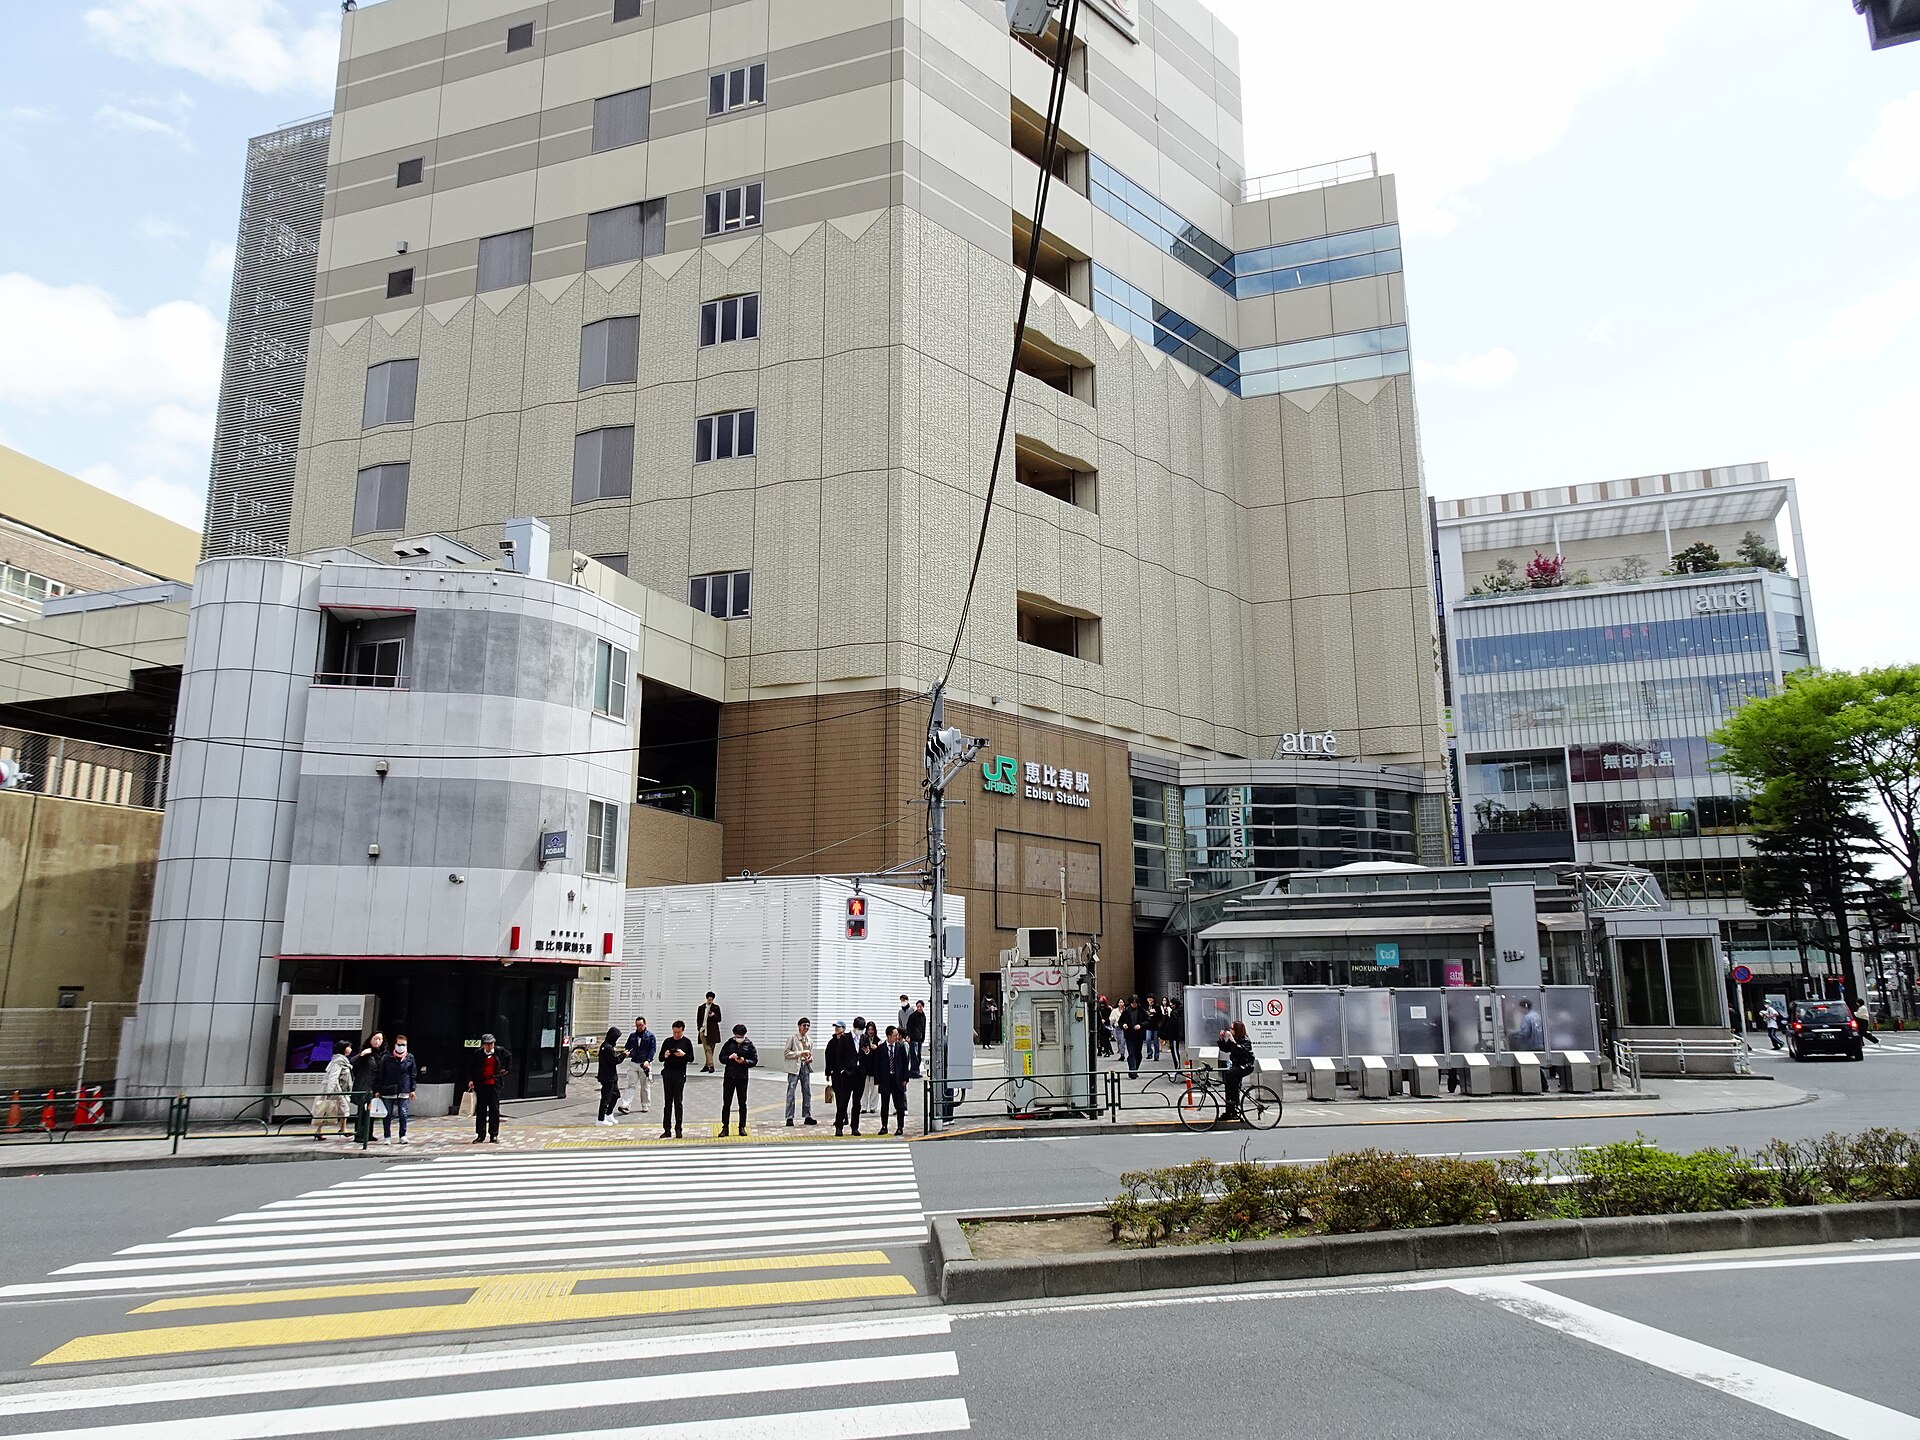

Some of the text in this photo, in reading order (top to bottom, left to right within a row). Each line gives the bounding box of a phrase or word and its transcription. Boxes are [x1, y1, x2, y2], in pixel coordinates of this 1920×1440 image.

[1695, 587, 1750, 611] atré
[1282, 728, 1337, 753] atré
[983, 755, 1018, 785] JR
[1602, 751, 1676, 770] 無印良品
[1024, 761, 1090, 793] 恵比寿駅
[1025, 785, 1090, 808] Ebisu Station
[545, 847, 565, 855] KOBAN
[1010, 970, 1062, 987] 宝くじ
